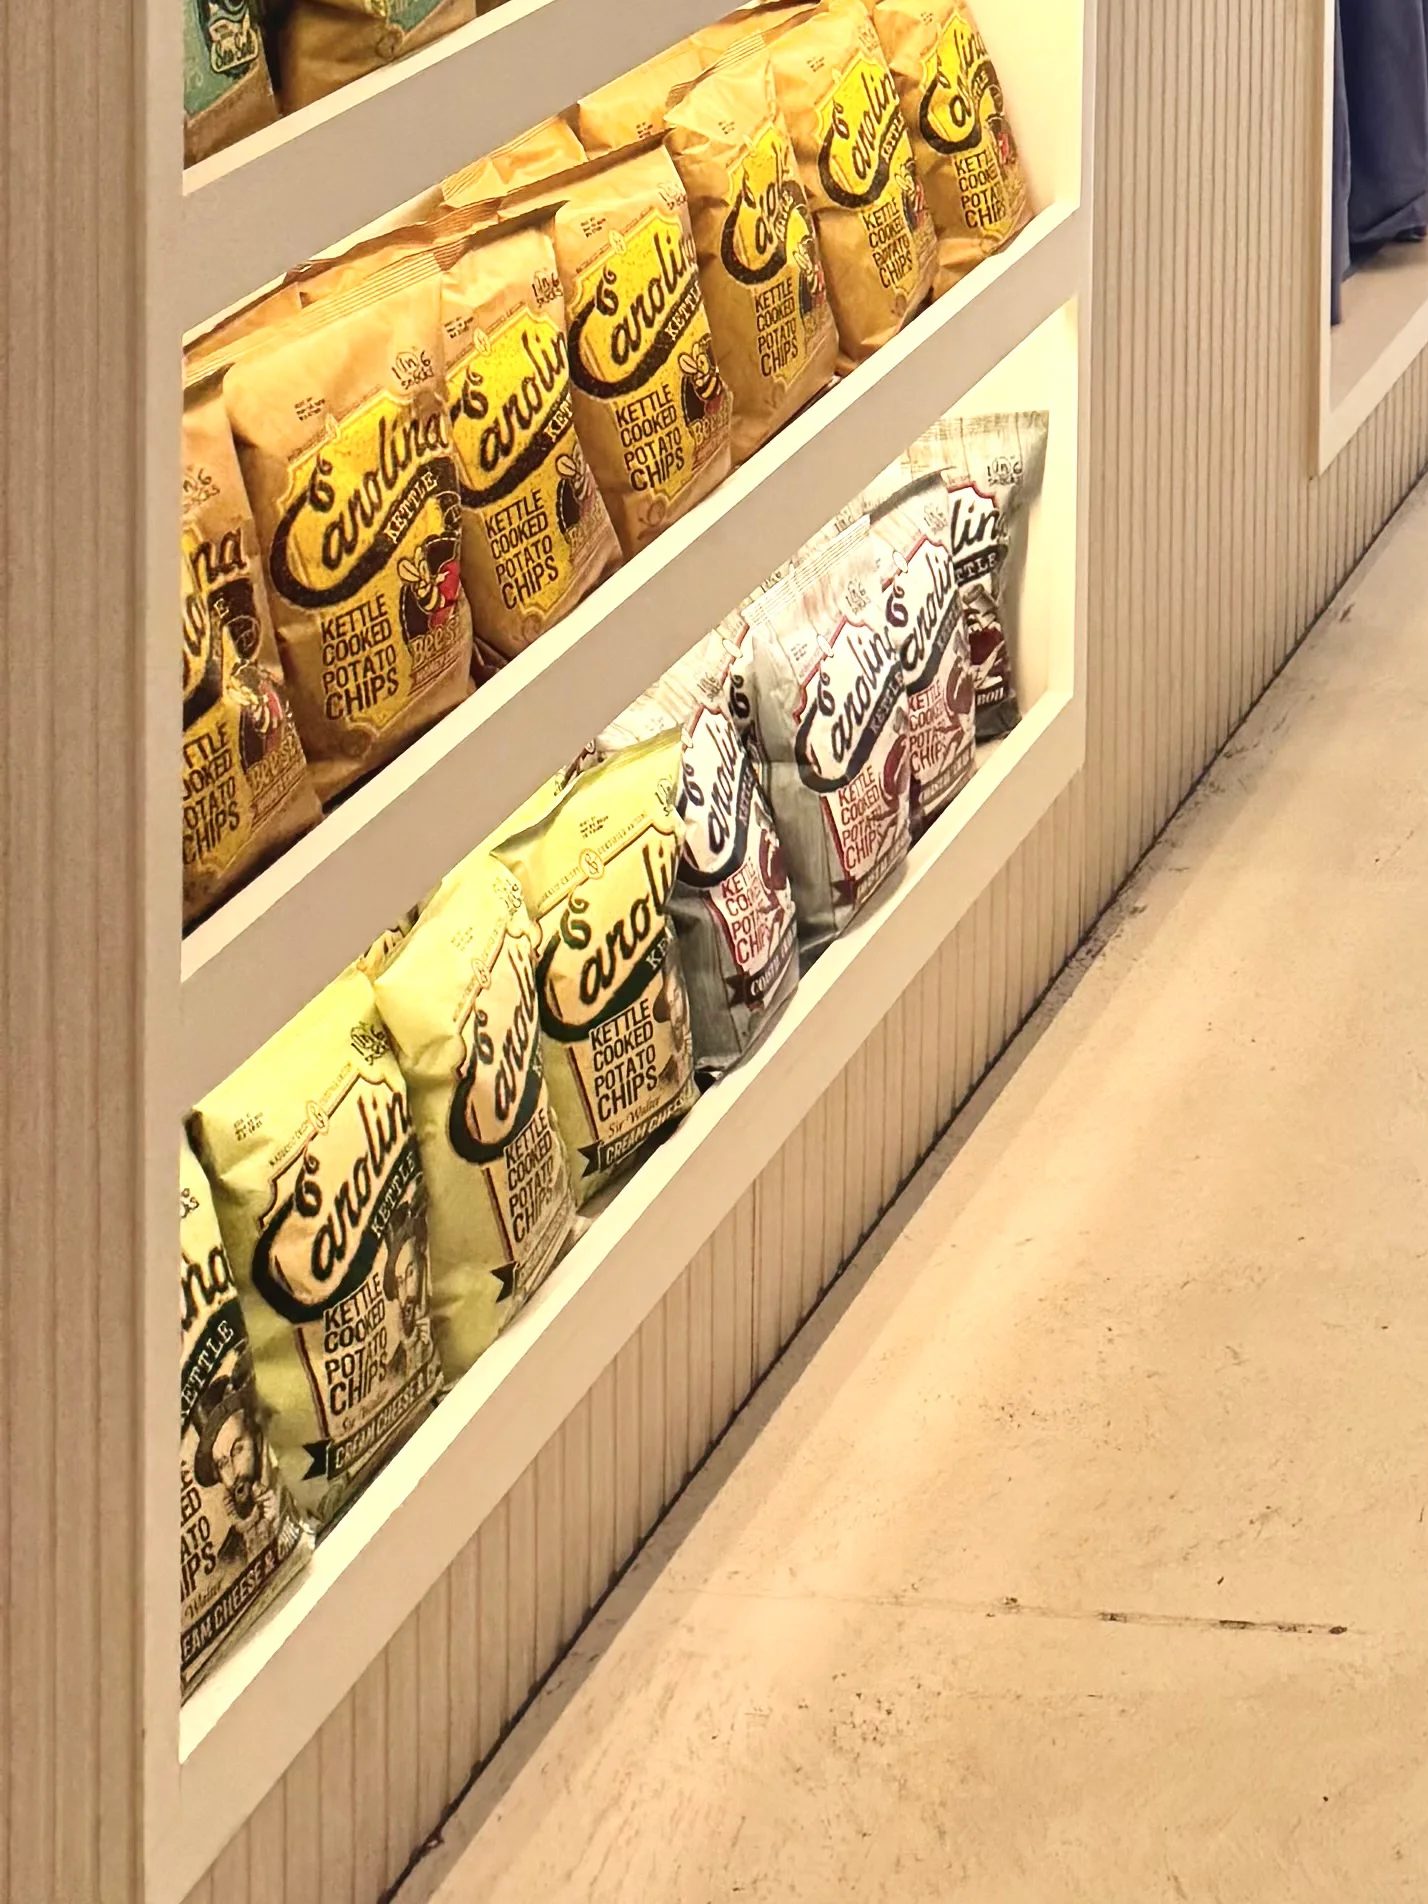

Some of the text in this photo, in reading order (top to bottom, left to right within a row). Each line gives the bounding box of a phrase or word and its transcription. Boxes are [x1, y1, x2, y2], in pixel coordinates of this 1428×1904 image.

[818, 70, 898, 210] Carolin
[754, 276, 793, 313] KETTLE
[757, 317, 796, 355] POTATO
[760, 336, 799, 378] CHIPS
[615, 383, 674, 427] KETTLE
[620, 403, 678, 448] COOKED
[624, 426, 683, 473] POTATO
[629, 448, 686, 493] CHIPS
[269, 413, 450, 609] Carolina
[383, 471, 438, 545] KETTLE
[485, 488, 544, 539] KETTLE
[490, 511, 549, 560] COOKED
[496, 534, 553, 586] POTATO
[502, 556, 559, 611] CHIPS
[955, 553, 998, 584] TTLE
[321, 593, 388, 643] KETTLE
[322, 617, 392, 667] COOKED
[322, 644, 397, 695] POTATO
[325, 666, 399, 721] CHIPS
[183, 721, 229, 769] TTLE
[184, 775, 236, 829] OTATO
[183, 802, 240, 864] CHIPS
[535, 842, 674, 1043] Caroli
[591, 997, 651, 1051] KETTLE
[593, 1021, 654, 1073] COOKED
[449, 942, 537, 1165] Caroli
[594, 1044, 656, 1098] POTATO
[597, 1064, 658, 1123] CHIPS
[506, 1107, 548, 1170] KETTLE
[507, 1130, 553, 1192] COOKED
[606, 1123, 648, 1165] CREAM
[251, 1090, 414, 1323] Carolin
[370, 1149, 418, 1239] KETTLE
[324, 1298, 386, 1354] COOKED
[325, 1272, 383, 1333] KETTLE
[325, 1326, 388, 1385] POTATO
[328, 1352, 388, 1416] CHIPS
[181, 1540, 217, 1603] IPS
[182, 1622, 213, 1662] EAM
[214, 1563, 268, 1629] CHEESE
